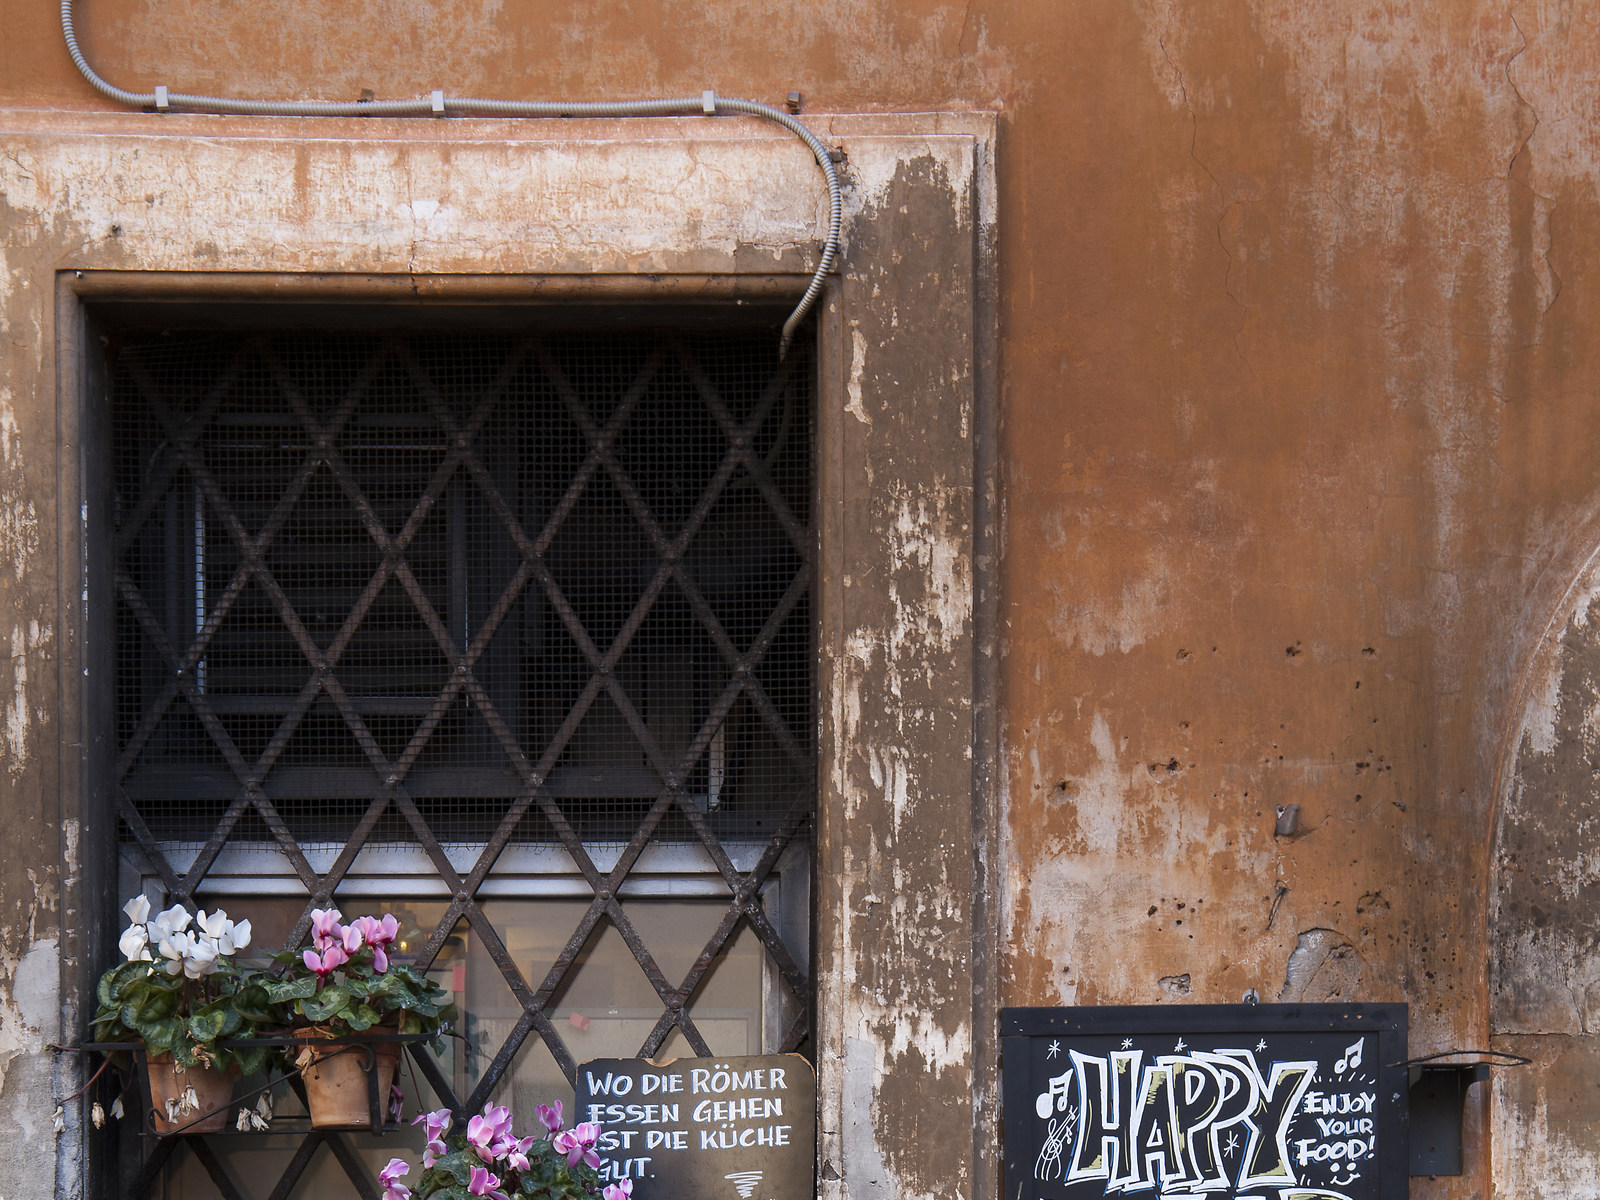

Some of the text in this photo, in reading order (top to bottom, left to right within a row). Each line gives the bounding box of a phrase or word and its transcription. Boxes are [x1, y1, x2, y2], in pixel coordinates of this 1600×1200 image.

[585, 1063, 788, 1096] WO DIE RÖMER
[584, 1097, 784, 1124] ESSEN GEHEN
[1304, 1091, 1376, 1116] ENJOY
[1064, 1048, 1318, 1194] HAPPY
[1316, 1118, 1374, 1137] YOUR
[592, 1122, 792, 1151] ST DIE KÜCHE
[1294, 1135, 1376, 1166] FOOD!
